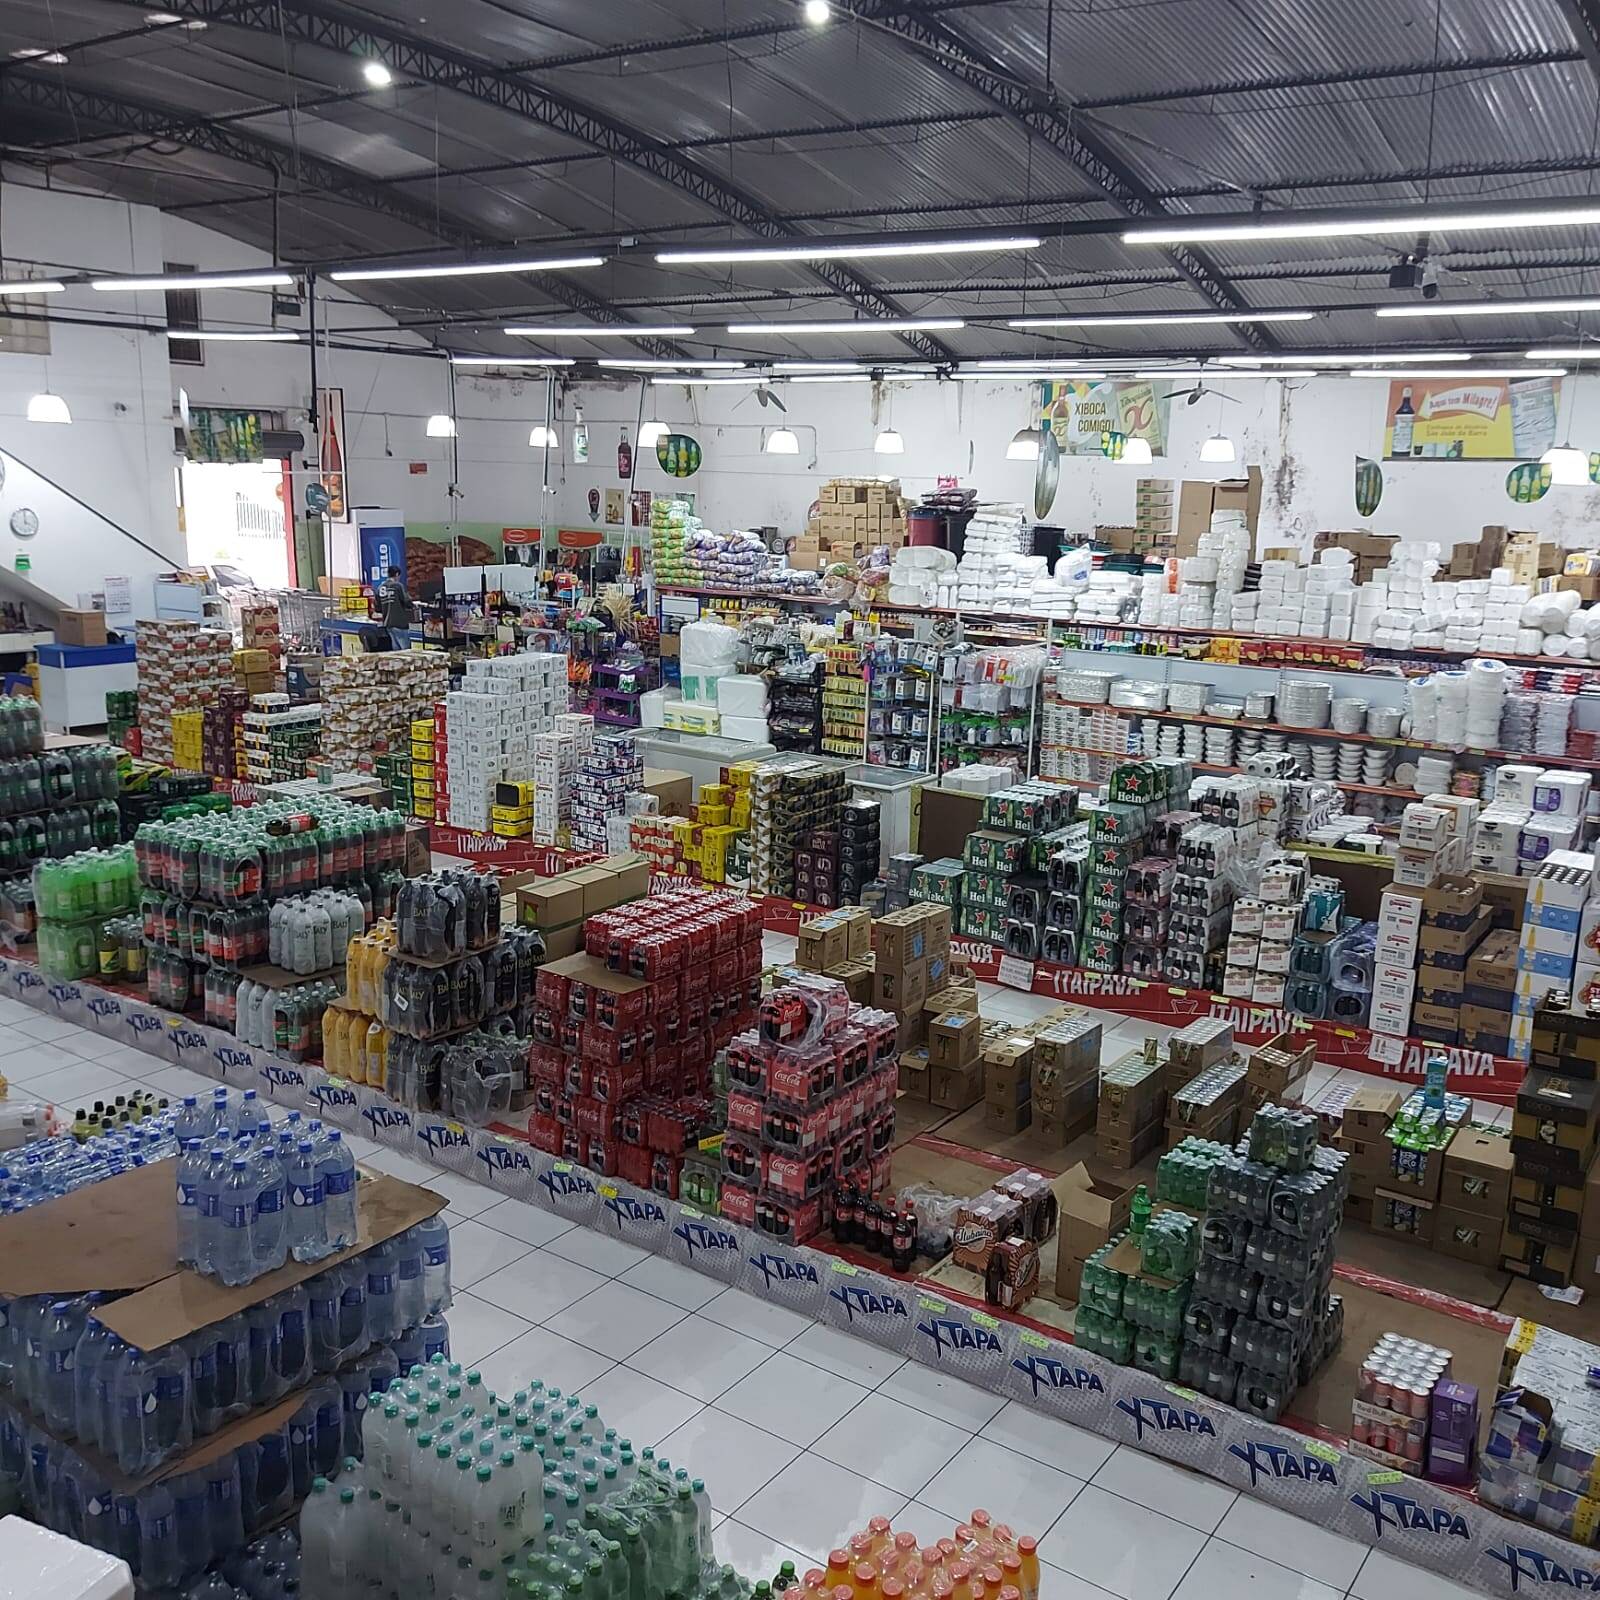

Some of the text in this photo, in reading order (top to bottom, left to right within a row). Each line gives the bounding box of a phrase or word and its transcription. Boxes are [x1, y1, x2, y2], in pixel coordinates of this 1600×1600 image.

[1074, 402, 1106, 415] XIBOCA
[1462, 392, 1497, 409] Milagre!
[1078, 419, 1115, 432] COMIGO!
[1054, 970, 1141, 995] ITAIPAVA
[1209, 1003, 1306, 1034] ITAIPAVA
[168, 1030, 207, 1057] XTAPA
[213, 1048, 253, 1076] XTAPA
[259, 1066, 306, 1095] XTAPA
[309, 1085, 357, 1114] XTAPA
[362, 1105, 411, 1136] XTAPA
[417, 1125, 471, 1157] XTAPA
[477, 1146, 532, 1180] XTAPA
[537, 1170, 597, 1203] XTAPA
[604, 1197, 666, 1230] XTAPA
[672, 1222, 739, 1259] XTAPA
[749, 1253, 819, 1290] XTAPA
[829, 1284, 908, 1323] XTAPA
[915, 1317, 1002, 1359] XTAPA
[1011, 1353, 1105, 1399] XTAPA
[1115, 1396, 1217, 1442] XTAPA
[1228, 1440, 1339, 1488] XTAPA
[1350, 1490, 1472, 1542] XTAPA
